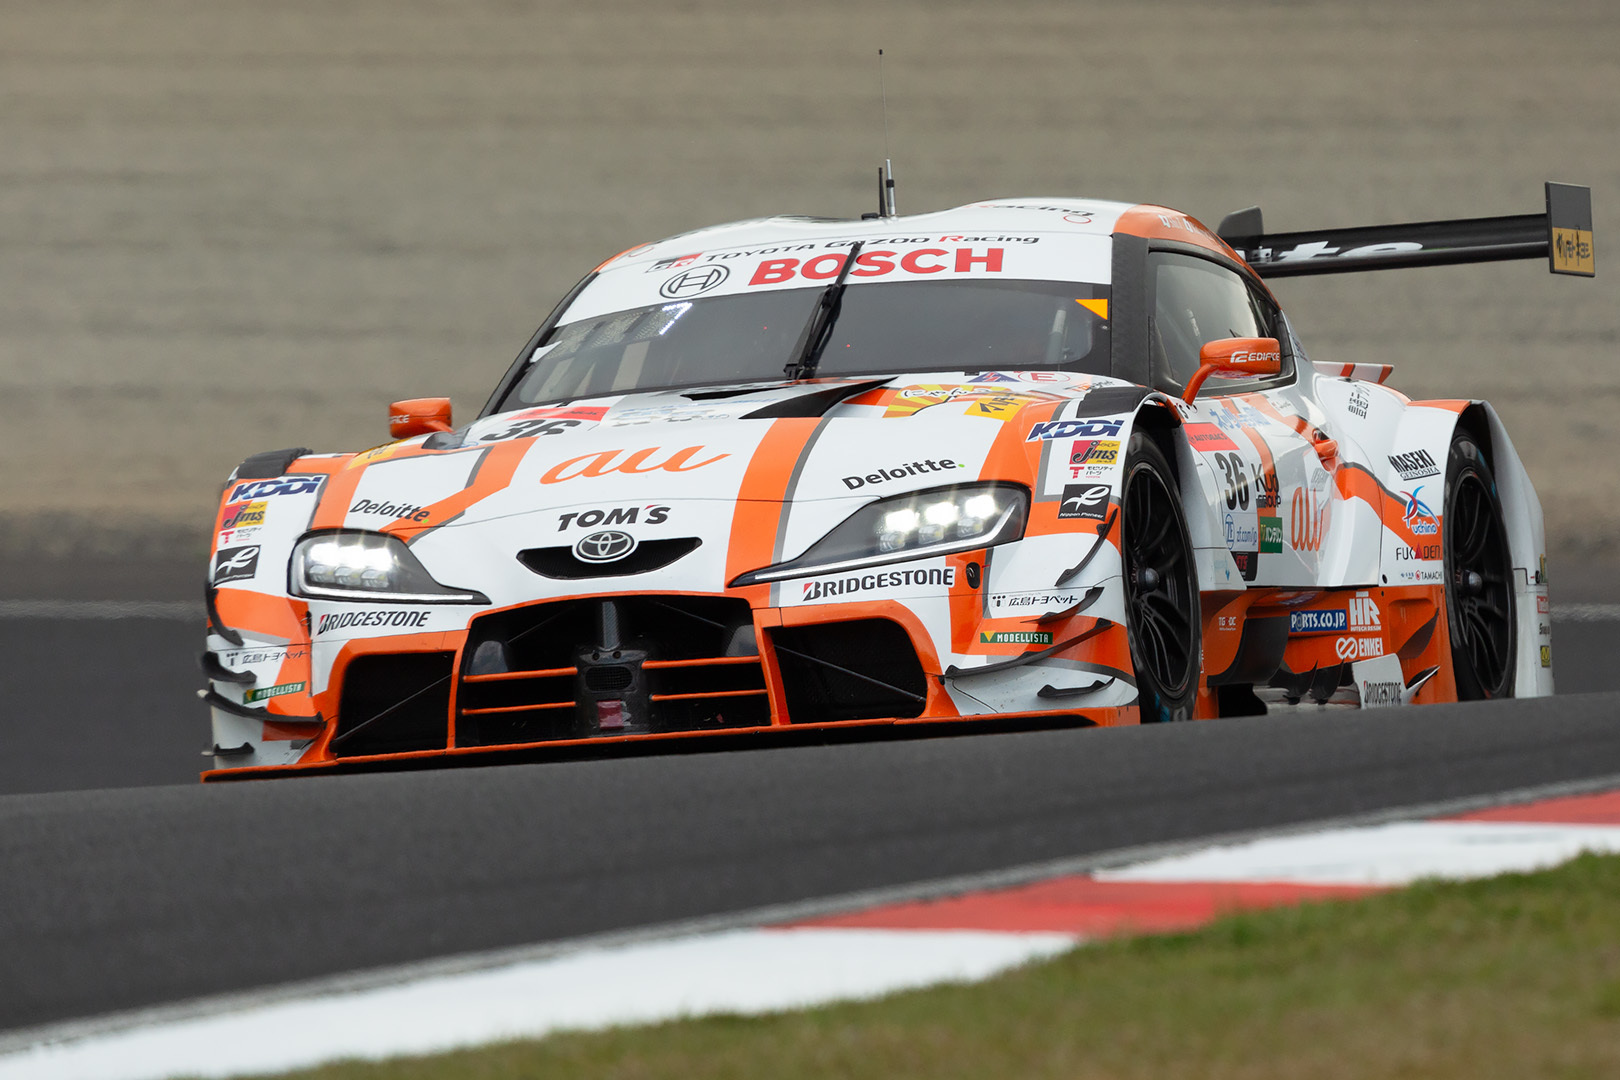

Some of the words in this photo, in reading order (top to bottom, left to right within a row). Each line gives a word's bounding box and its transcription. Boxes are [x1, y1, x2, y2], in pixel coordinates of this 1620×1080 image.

[706, 244, 815, 262] TOYOTA
[938, 235, 1040, 245] Racing
[748, 248, 1004, 286] BOSCH
[1248, 352, 1280, 362] EDIFICE
[479, 419, 582, 441] 36
[1027, 419, 1125, 441] KDDI
[539, 445, 732, 485] au
[1387, 449, 1436, 474] MASEKI
[229, 477, 323, 503] KDDI
[1214, 452, 1249, 511] 36
[557, 504, 672, 532] TOM'S
[1411, 518, 1437, 534] uchino
[803, 567, 955, 602] BRIDGESTONE
[1008, 594, 1079, 607] 広島トヨペット
[317, 611, 432, 636] BRIDGESTONE
[996, 632, 1050, 644] MODELLISTA
[1358, 637, 1384, 657] ENKEI
[242, 650, 309, 665] 広島トヨペット
[256, 682, 304, 700] MODELLISTA
